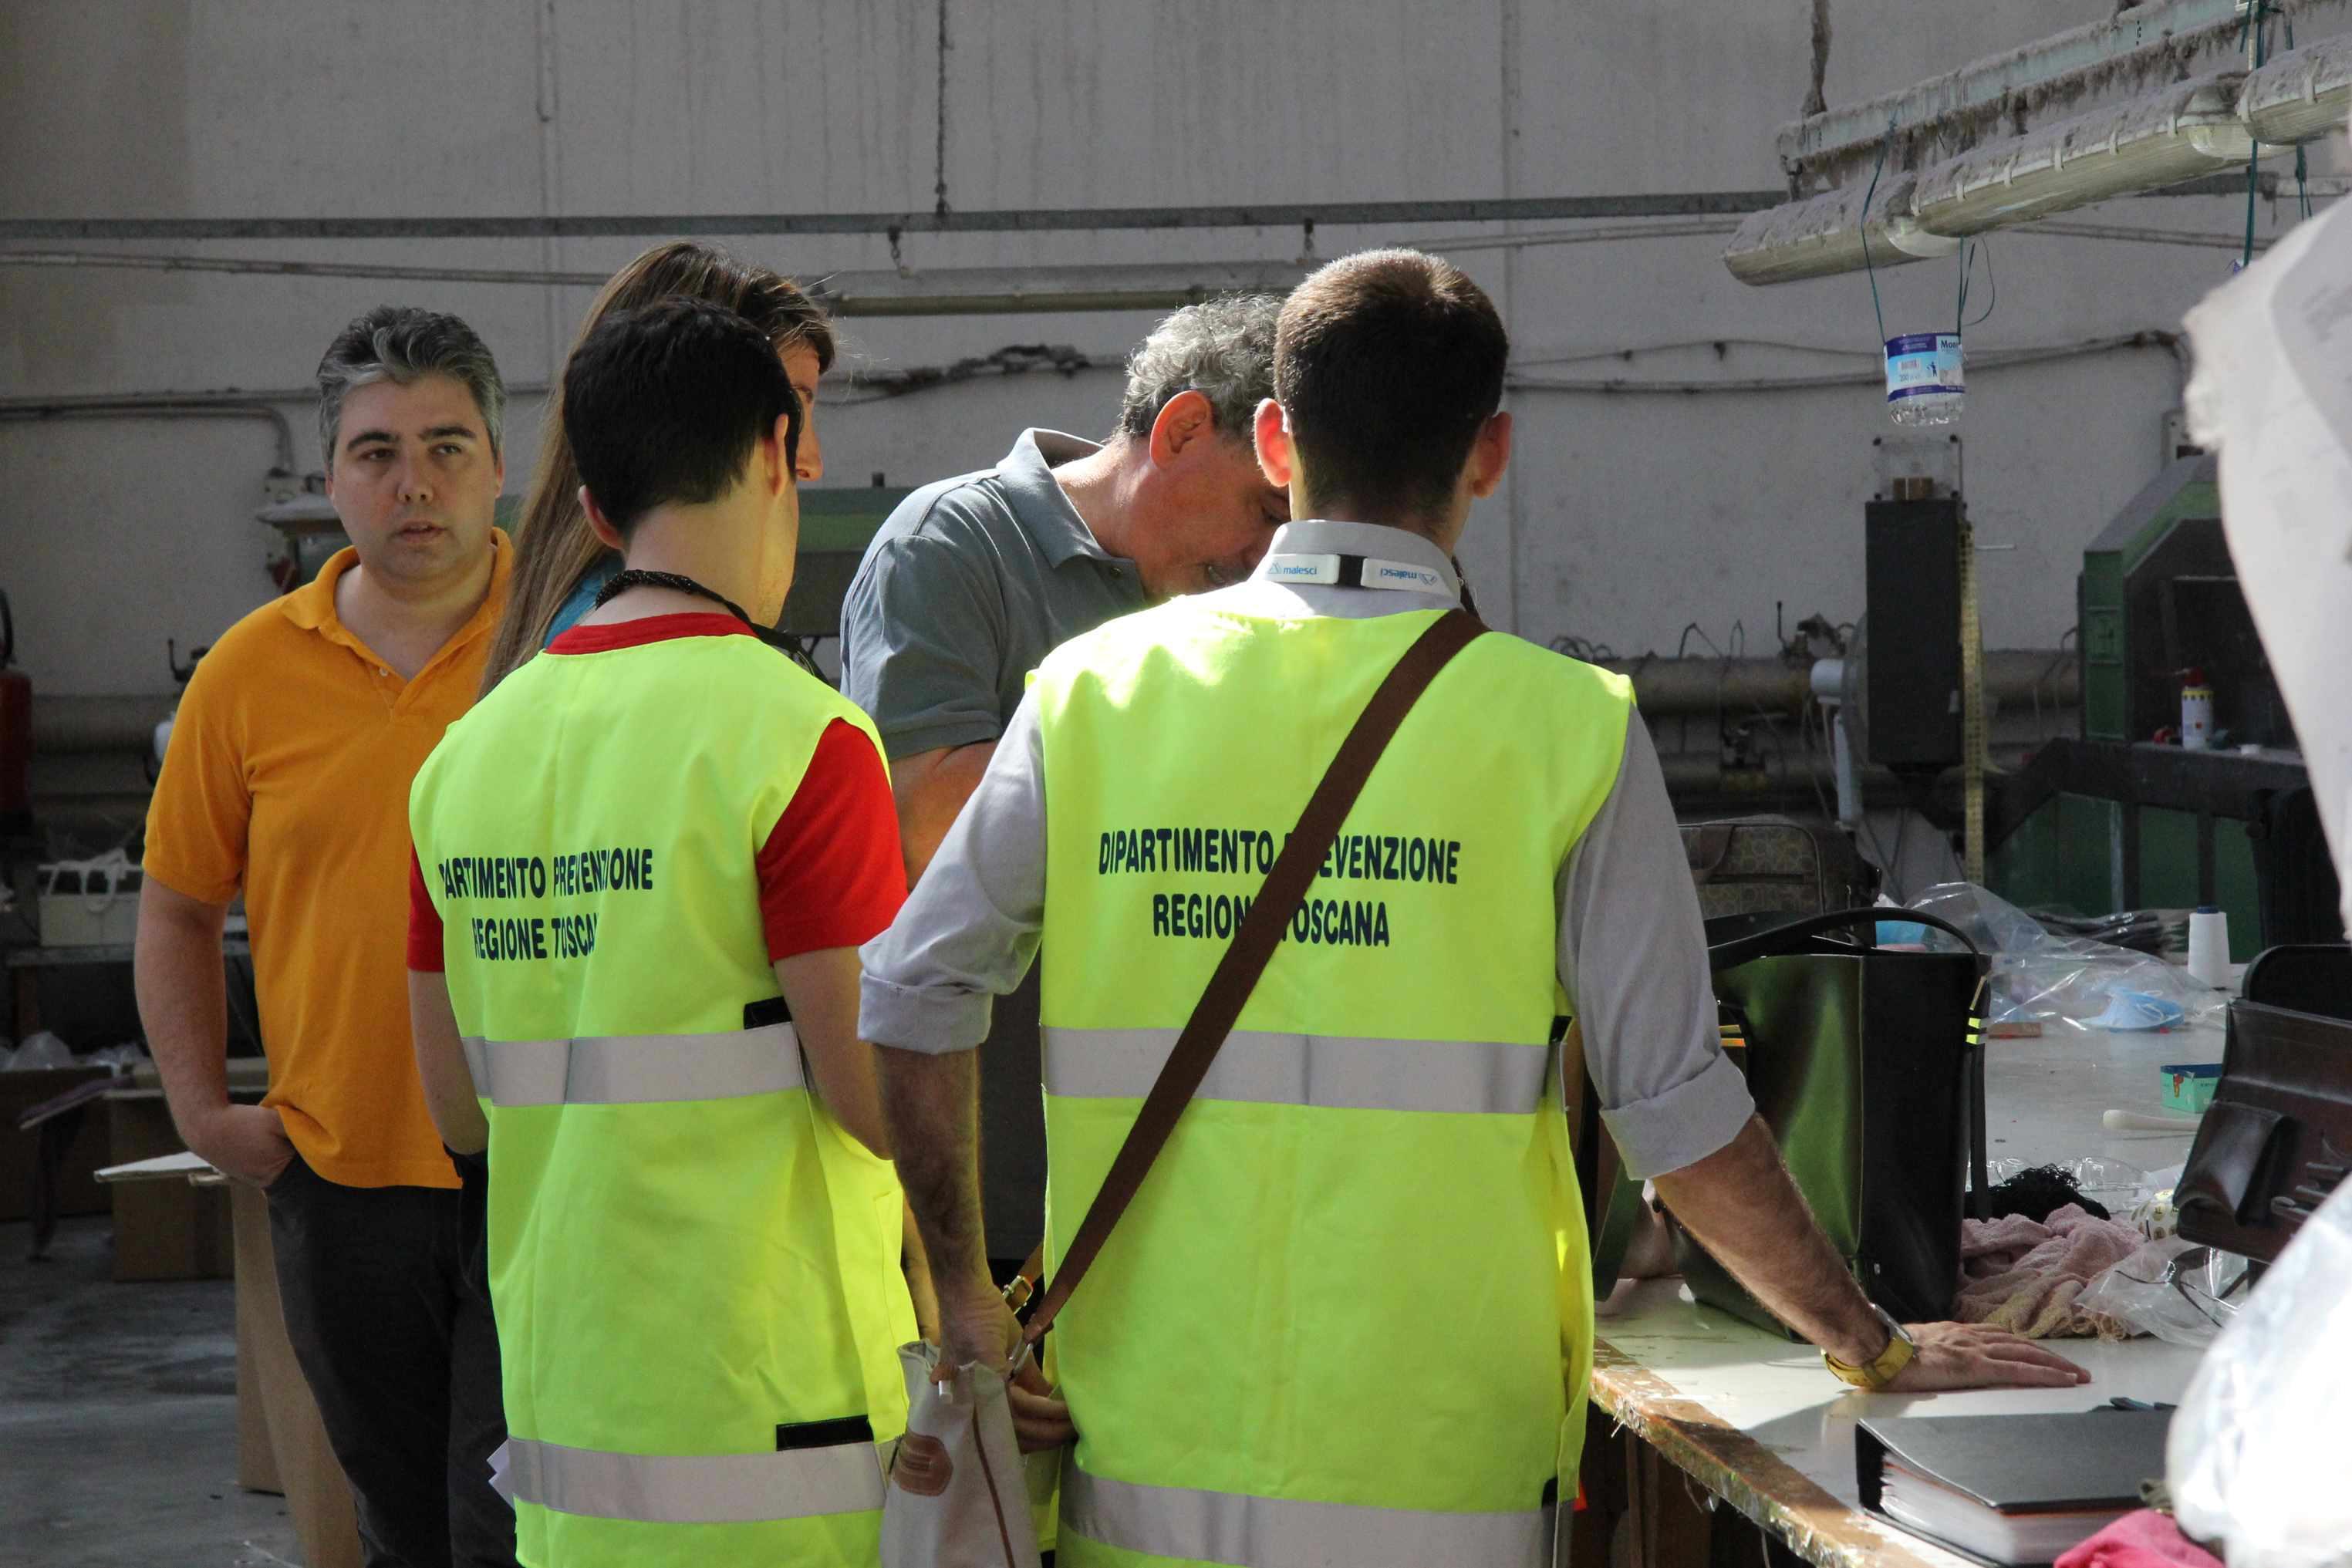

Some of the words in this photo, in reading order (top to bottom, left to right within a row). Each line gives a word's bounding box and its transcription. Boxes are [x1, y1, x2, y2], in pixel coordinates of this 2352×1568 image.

[1283, 565, 1318, 575] malesci
[1098, 828, 1274, 875] DIPARTIMENTO
[1284, 832, 1461, 885] EVENZIONE
[1152, 893, 1250, 939] REGION
[1281, 899, 1390, 948] OSCANA
